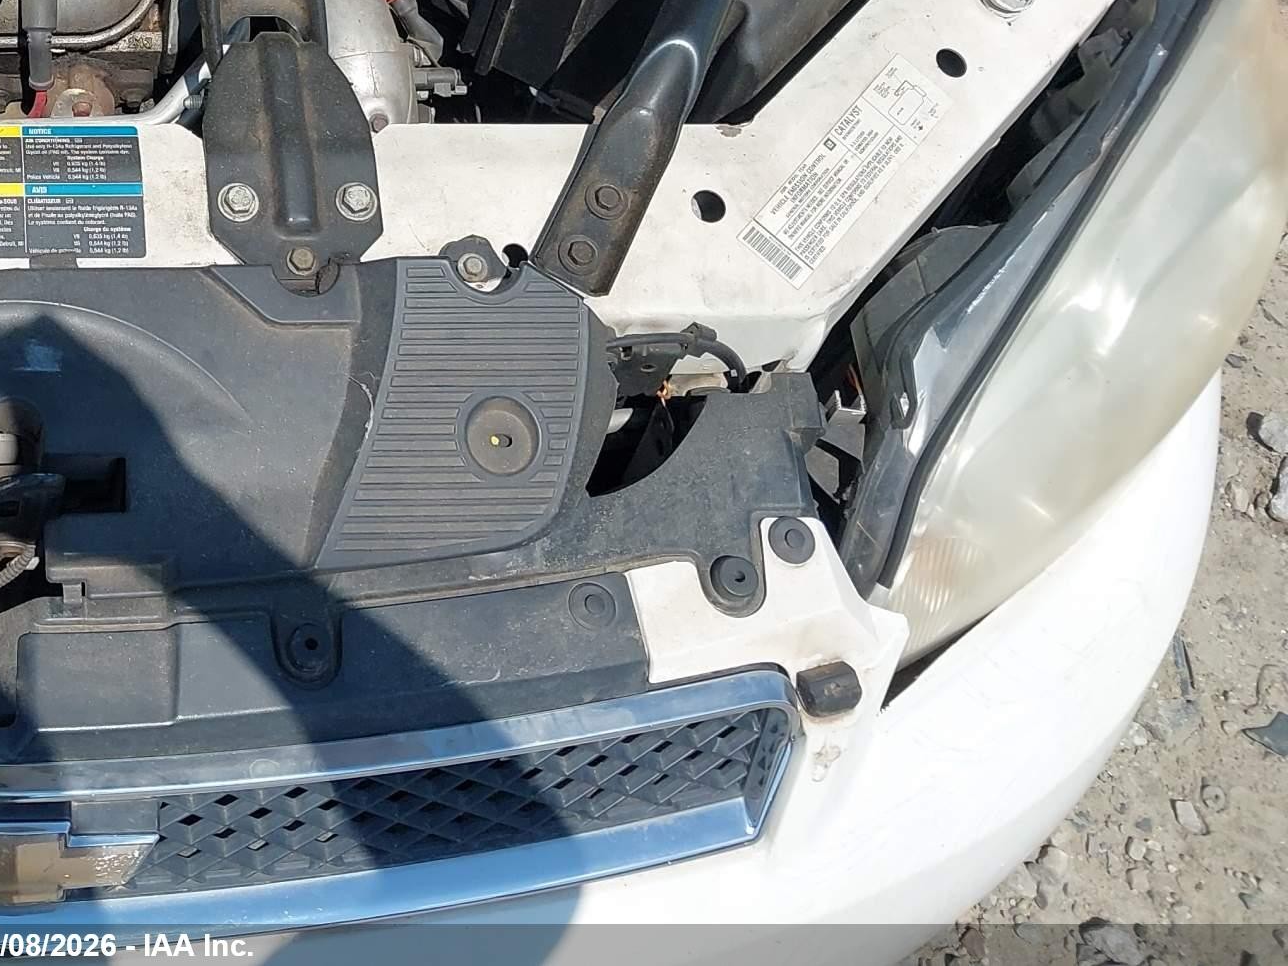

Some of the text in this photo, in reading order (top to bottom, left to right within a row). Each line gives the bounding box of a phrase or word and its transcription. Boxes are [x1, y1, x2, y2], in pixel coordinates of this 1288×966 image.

[834, 105, 863, 136] CATALYST
[770, 152, 826, 216] VEHICLE EMISSION CONTROL
[789, 171, 819, 204] INFORMATION
